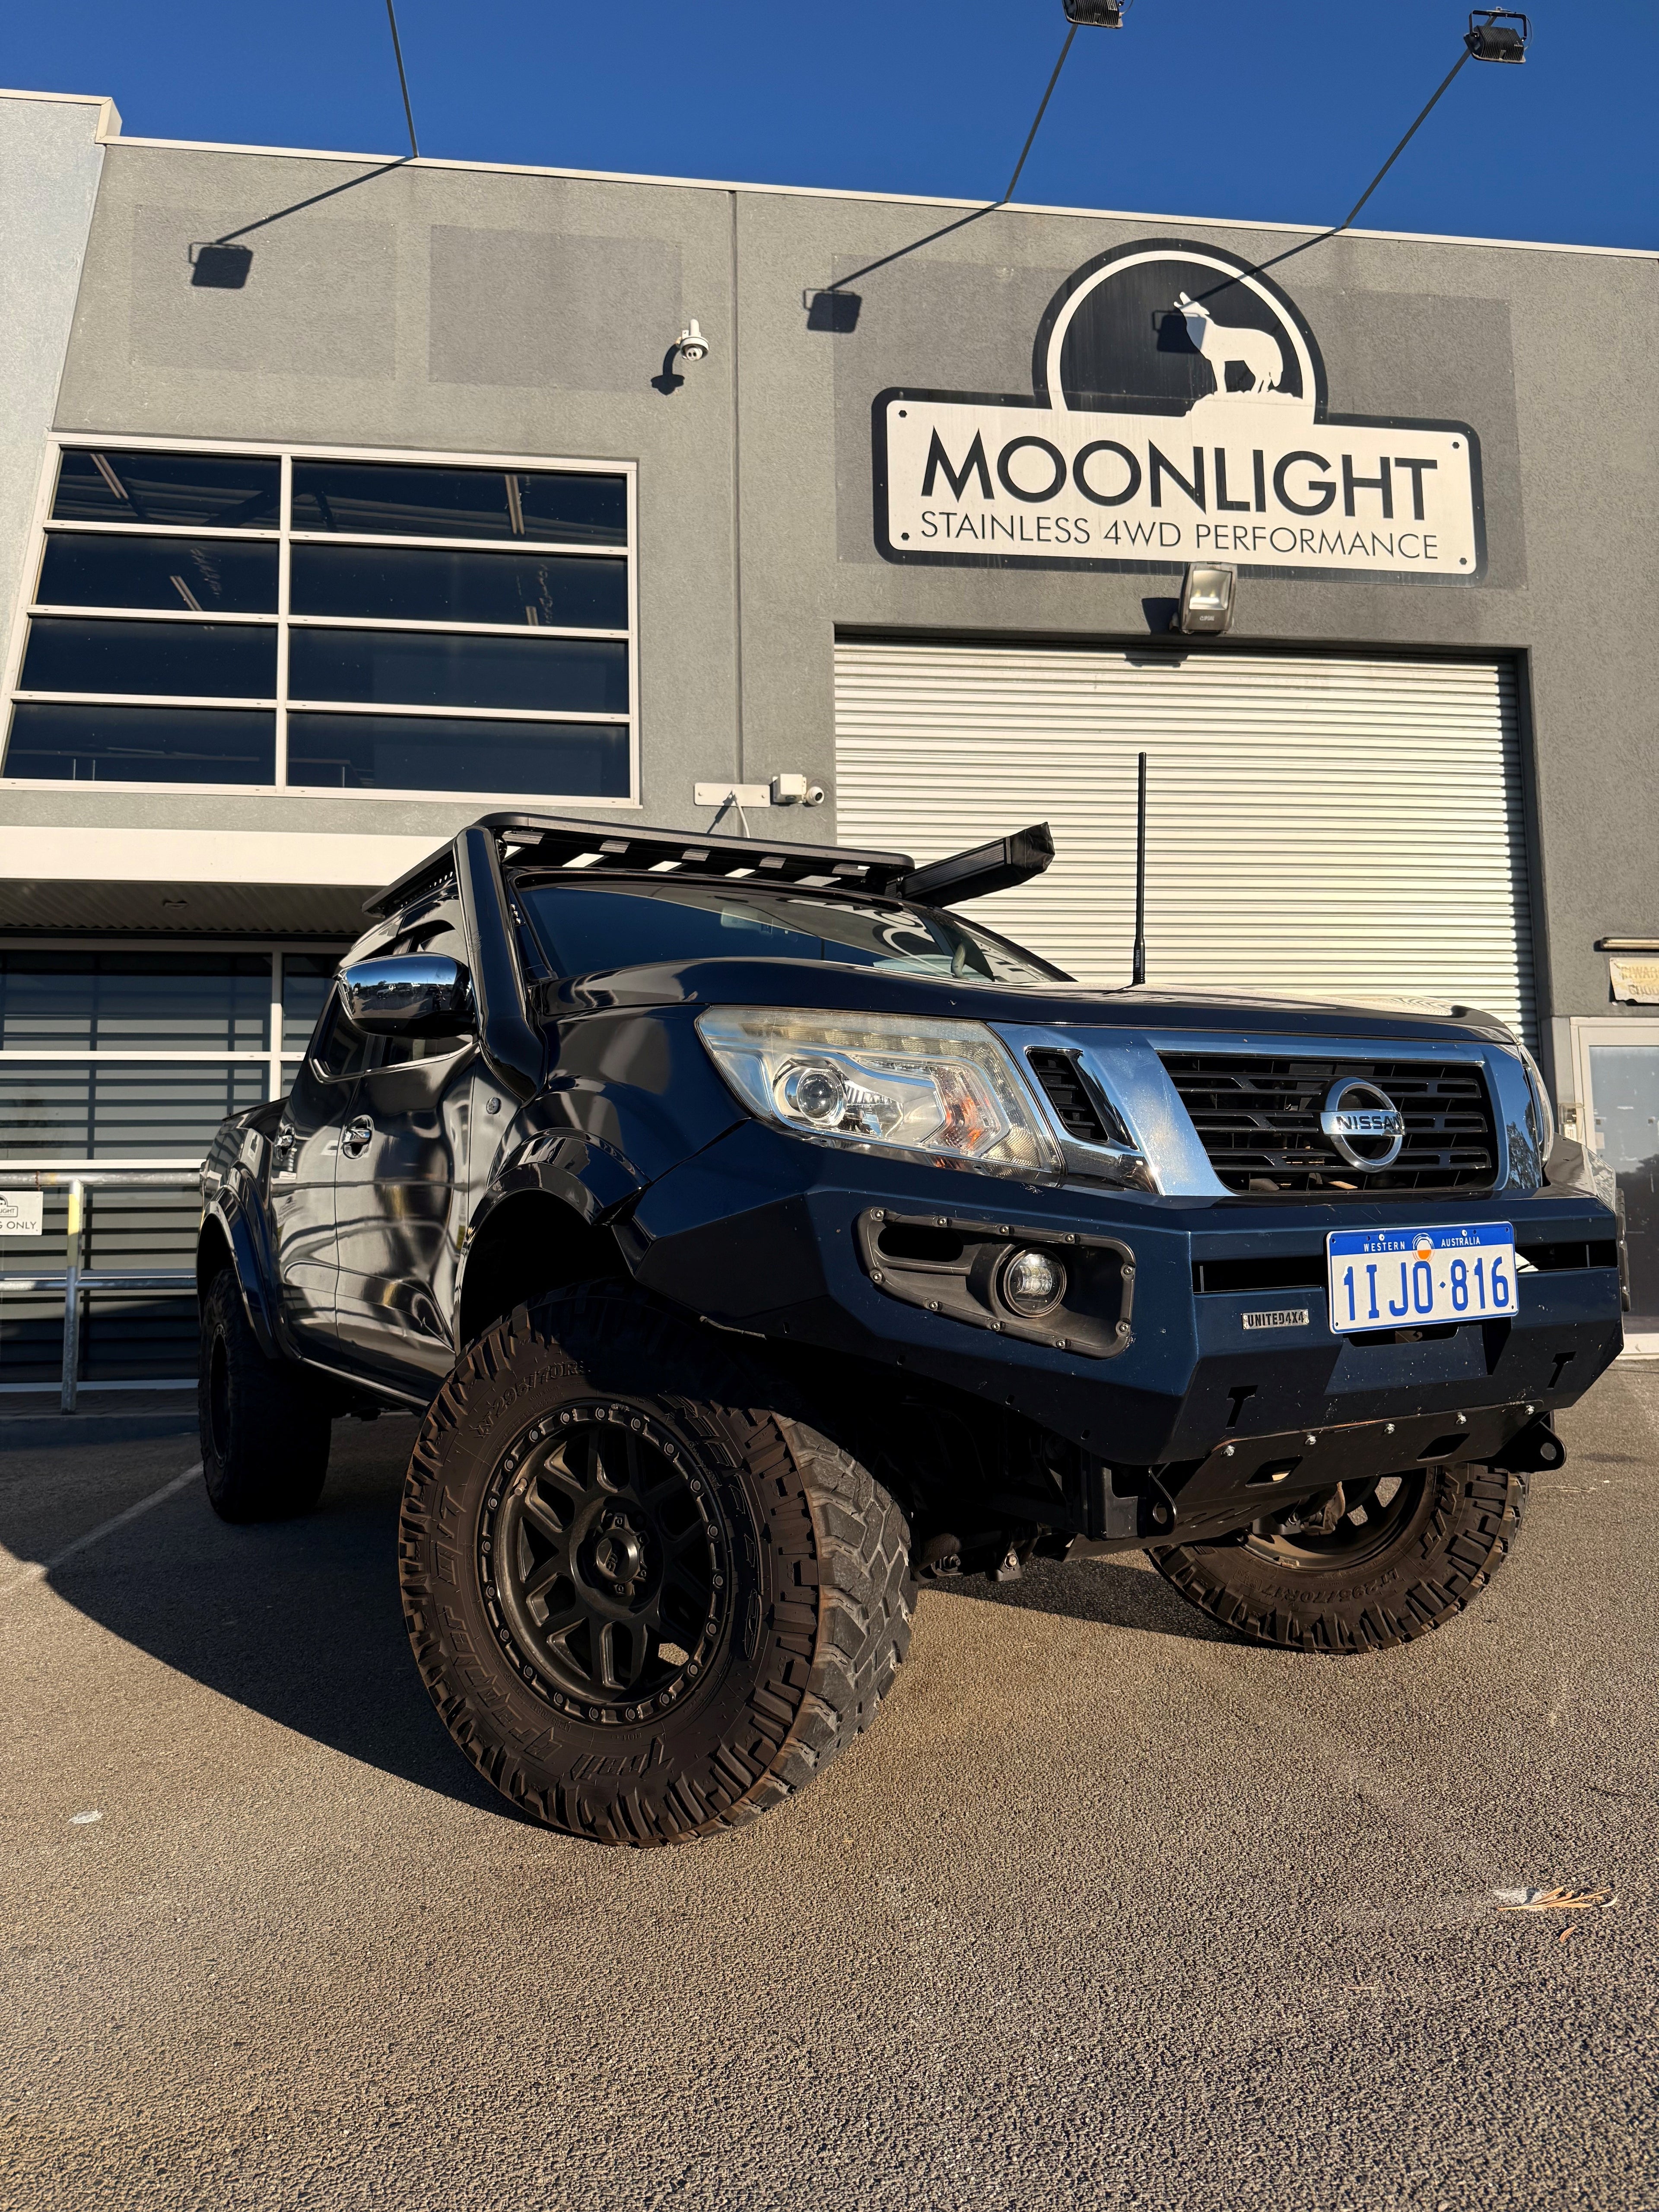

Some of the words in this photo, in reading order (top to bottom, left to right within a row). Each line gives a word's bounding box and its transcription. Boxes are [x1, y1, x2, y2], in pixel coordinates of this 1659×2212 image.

[921, 426, 1438, 521] MOONLIGHT
[921, 510, 1090, 544] STAINLESS
[1103, 519, 1182, 547] 4WD
[1195, 524, 1438, 559] PERFORMANCE
[1336, 1116, 1403, 1130] NISSAN
[6, 1221, 36, 1229] ONLY
[1363, 1241, 1405, 1252] WESTERN
[1441, 1236, 1481, 1247] AUSTRALIA
[1247, 1311, 1304, 1327] UNITED4X4
[492, 1360, 588, 1417] 295/70R
